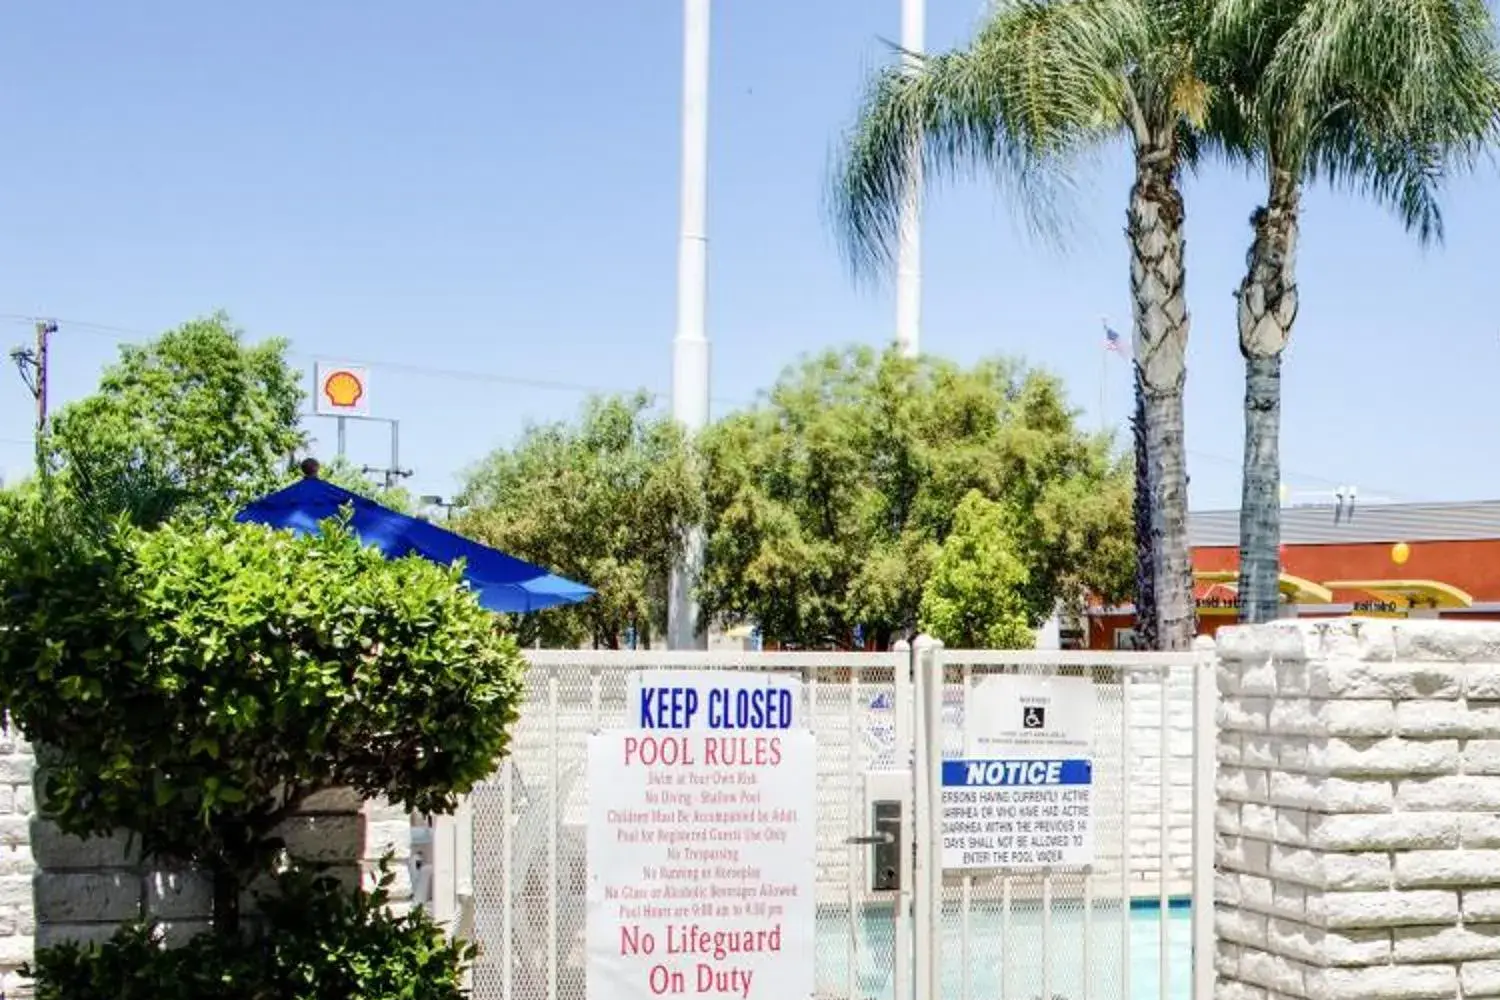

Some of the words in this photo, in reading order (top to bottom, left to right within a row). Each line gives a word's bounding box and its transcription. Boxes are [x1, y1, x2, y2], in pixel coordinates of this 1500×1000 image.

[640, 687, 698, 729] KEEP
[708, 687, 792, 729] CLOSED
[624, 737, 695, 766] POOL
[704, 737, 782, 766] RULES
[966, 762, 1064, 785] NOTICE
[645, 790, 658, 803] No
[667, 848, 681, 860] No
[642, 867, 657, 880] No
[605, 886, 618, 898] No
[620, 925, 655, 955] No
[666, 924, 781, 960] Lifeguard
[649, 964, 685, 995] On
[696, 963, 754, 999] Duty
